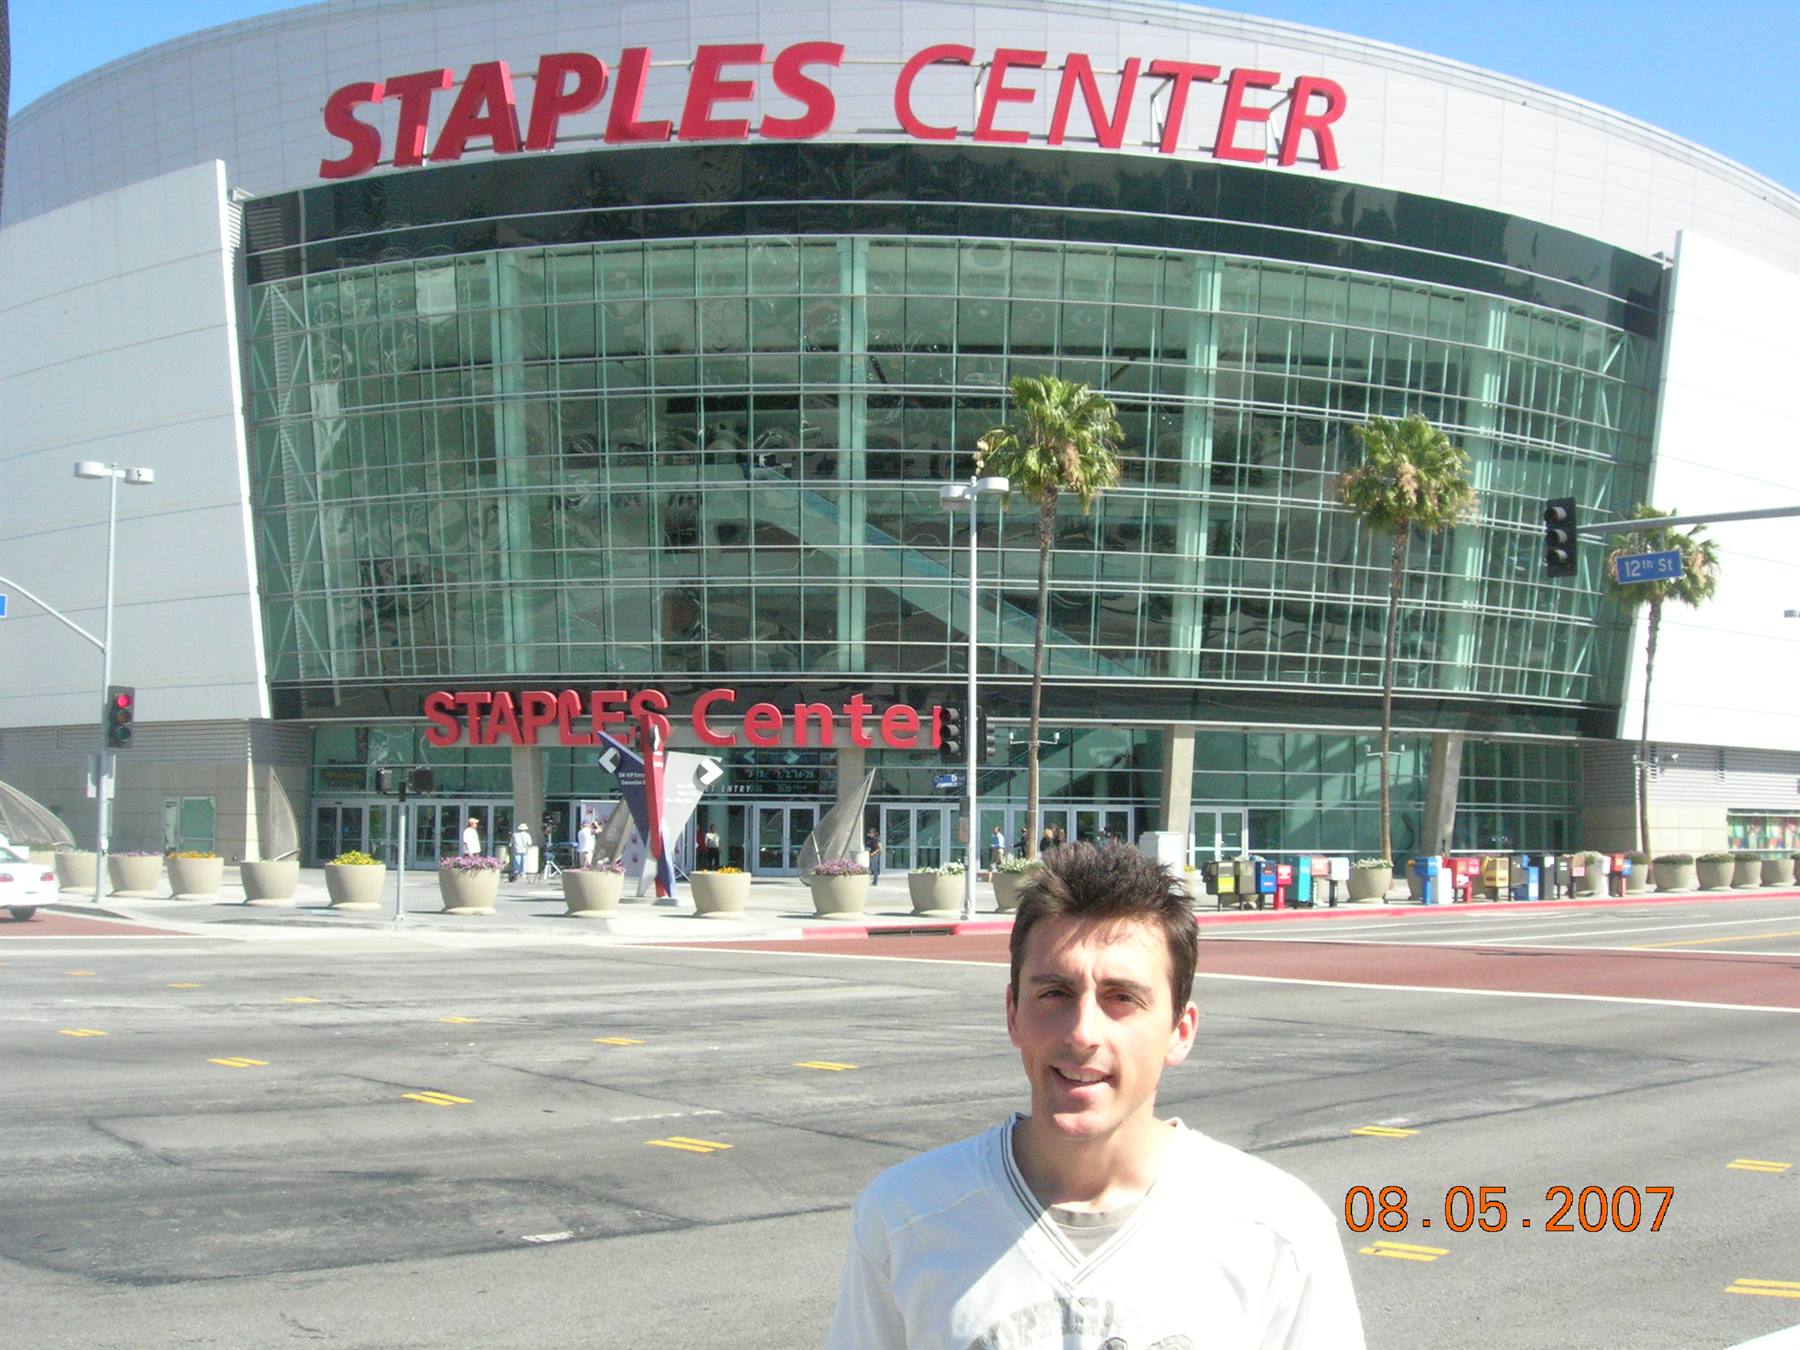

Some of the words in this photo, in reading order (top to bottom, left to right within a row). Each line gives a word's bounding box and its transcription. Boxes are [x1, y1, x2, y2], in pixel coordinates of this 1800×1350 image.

[319, 41, 846, 179] STAPLES
[894, 43, 1347, 171] CENTER
[1624, 560, 1654, 577] 12th
[1658, 558, 1673, 572] St
[423, 689, 671, 747] STAPLES
